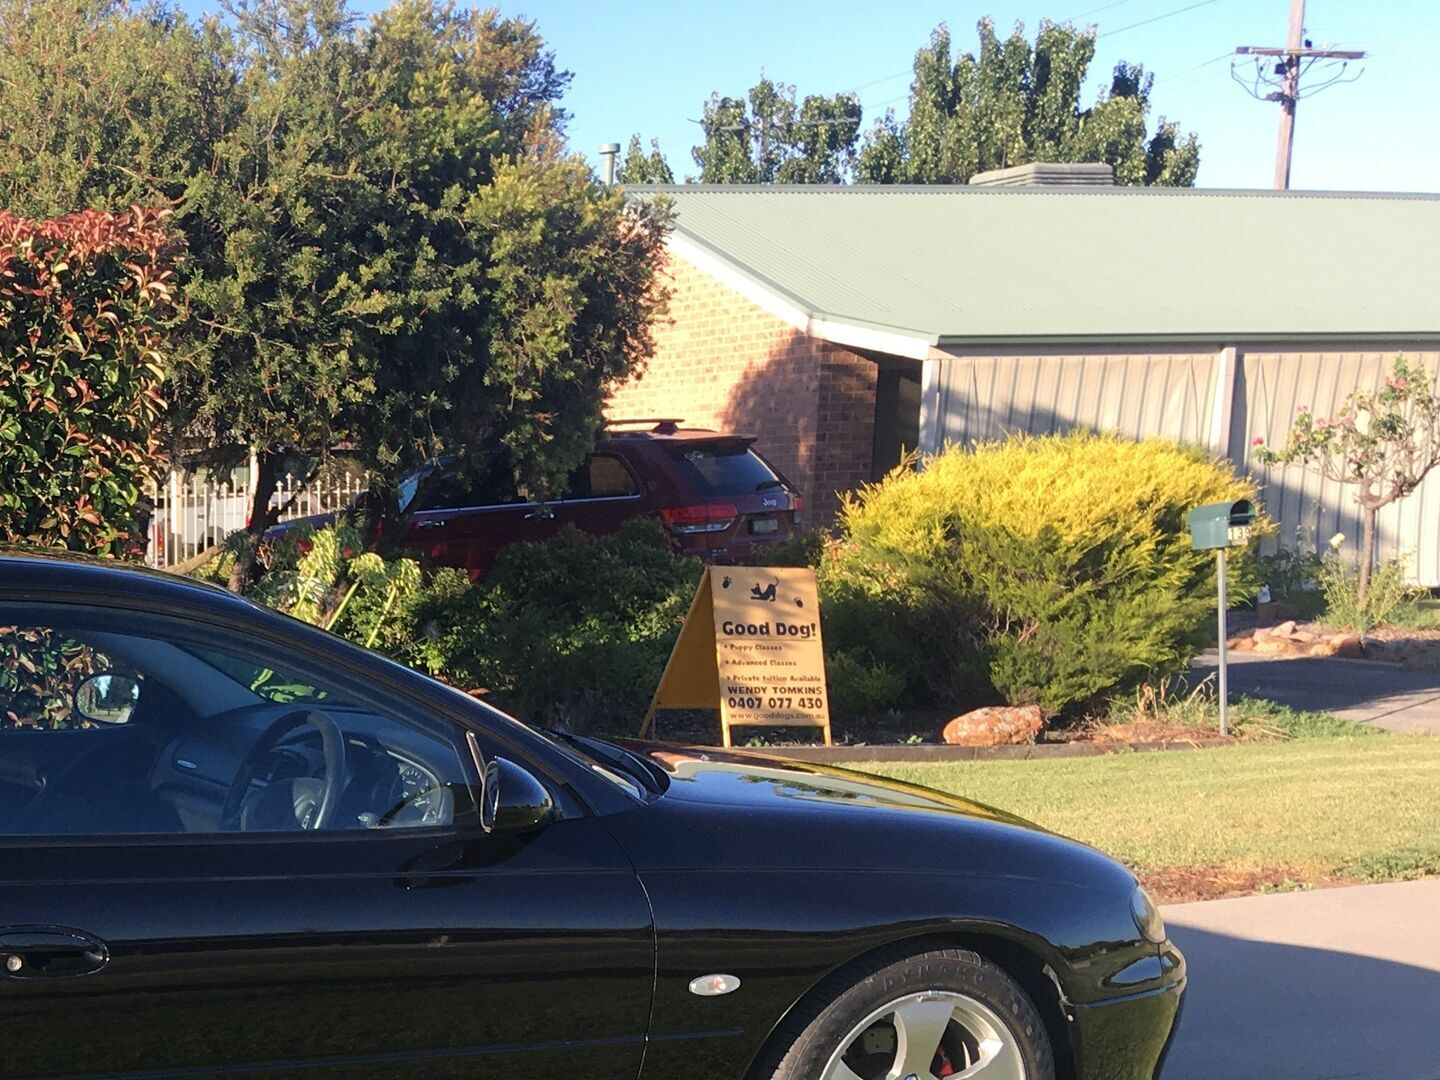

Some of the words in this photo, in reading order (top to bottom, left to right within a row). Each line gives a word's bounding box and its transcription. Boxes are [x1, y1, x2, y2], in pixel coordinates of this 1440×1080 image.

[722, 621, 770, 636] Good
[775, 622, 816, 638] Dog!
[728, 686, 767, 694] WENDY
[772, 686, 822, 695] TOMKINS
[728, 697, 762, 708] 0407
[768, 697, 792, 708] 077
[798, 697, 823, 708] 430
